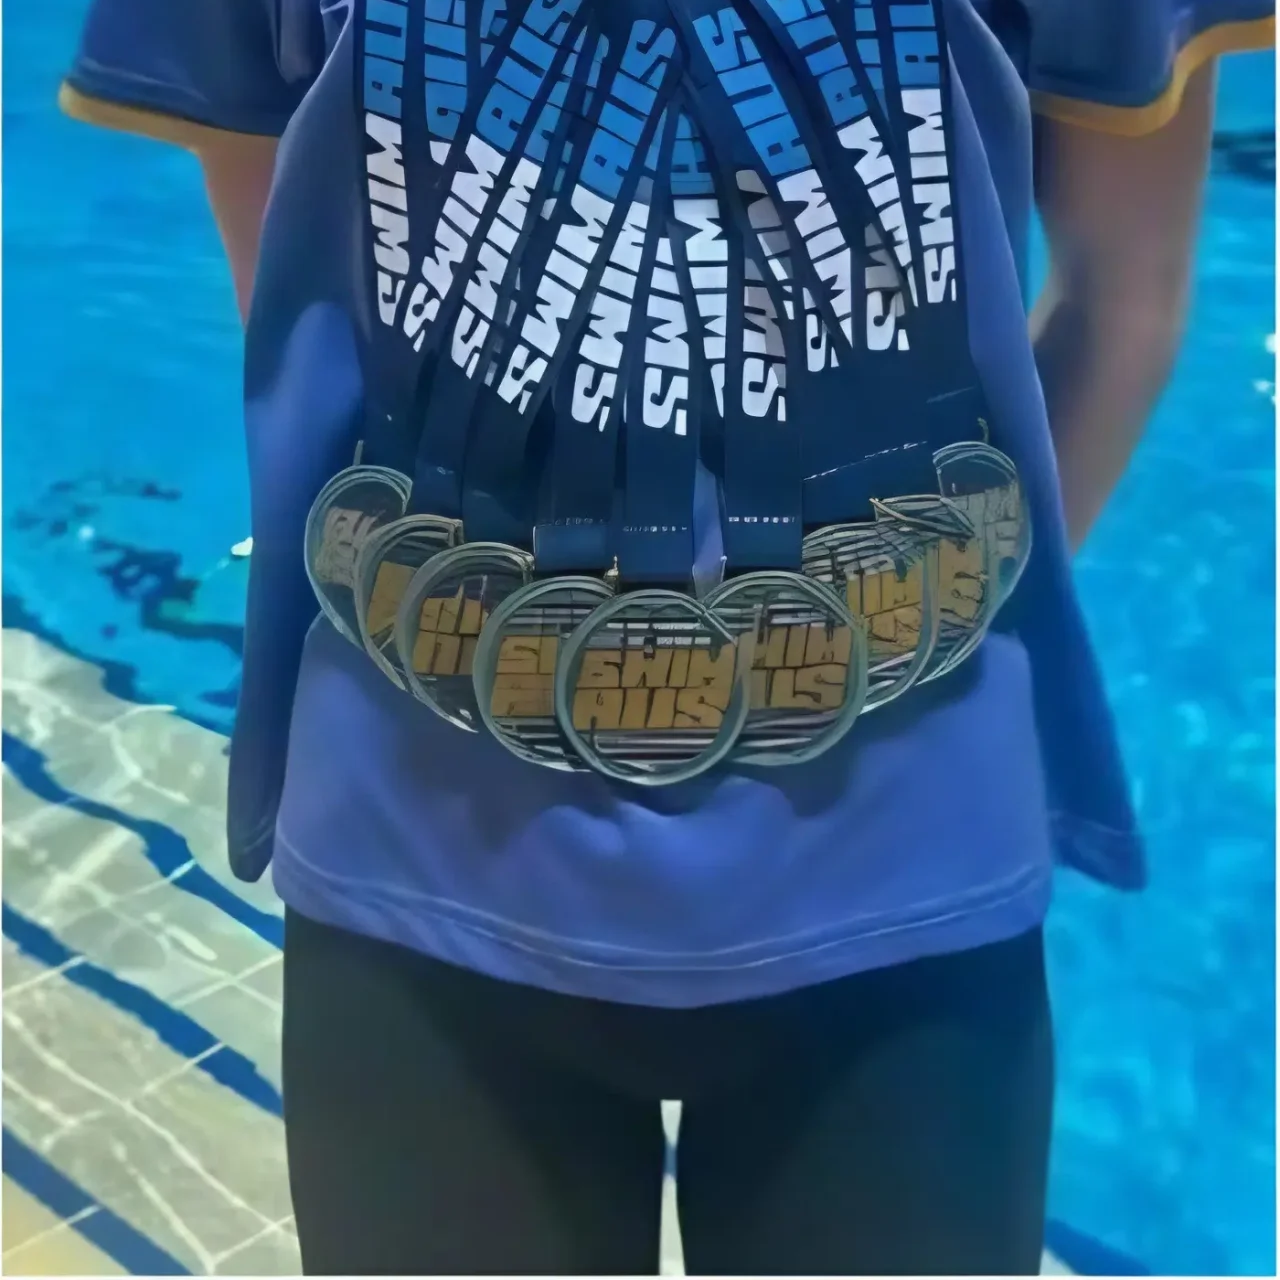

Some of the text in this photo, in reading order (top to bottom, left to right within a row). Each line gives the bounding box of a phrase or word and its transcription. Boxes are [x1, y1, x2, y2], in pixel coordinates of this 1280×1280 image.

[692, 6, 813, 177] AUS
[900, 88, 958, 303] SWIM
[365, 111, 410, 327] SWIM
[402, 133, 507, 353] SWIM
[450, 156, 543, 380] SWIM
[496, 183, 616, 415] SWIM
[578, 19, 677, 200] AUS
[570, 200, 651, 433] SWIM
[776, 168, 854, 349] WIM
[642, 236, 690, 436] SWI
